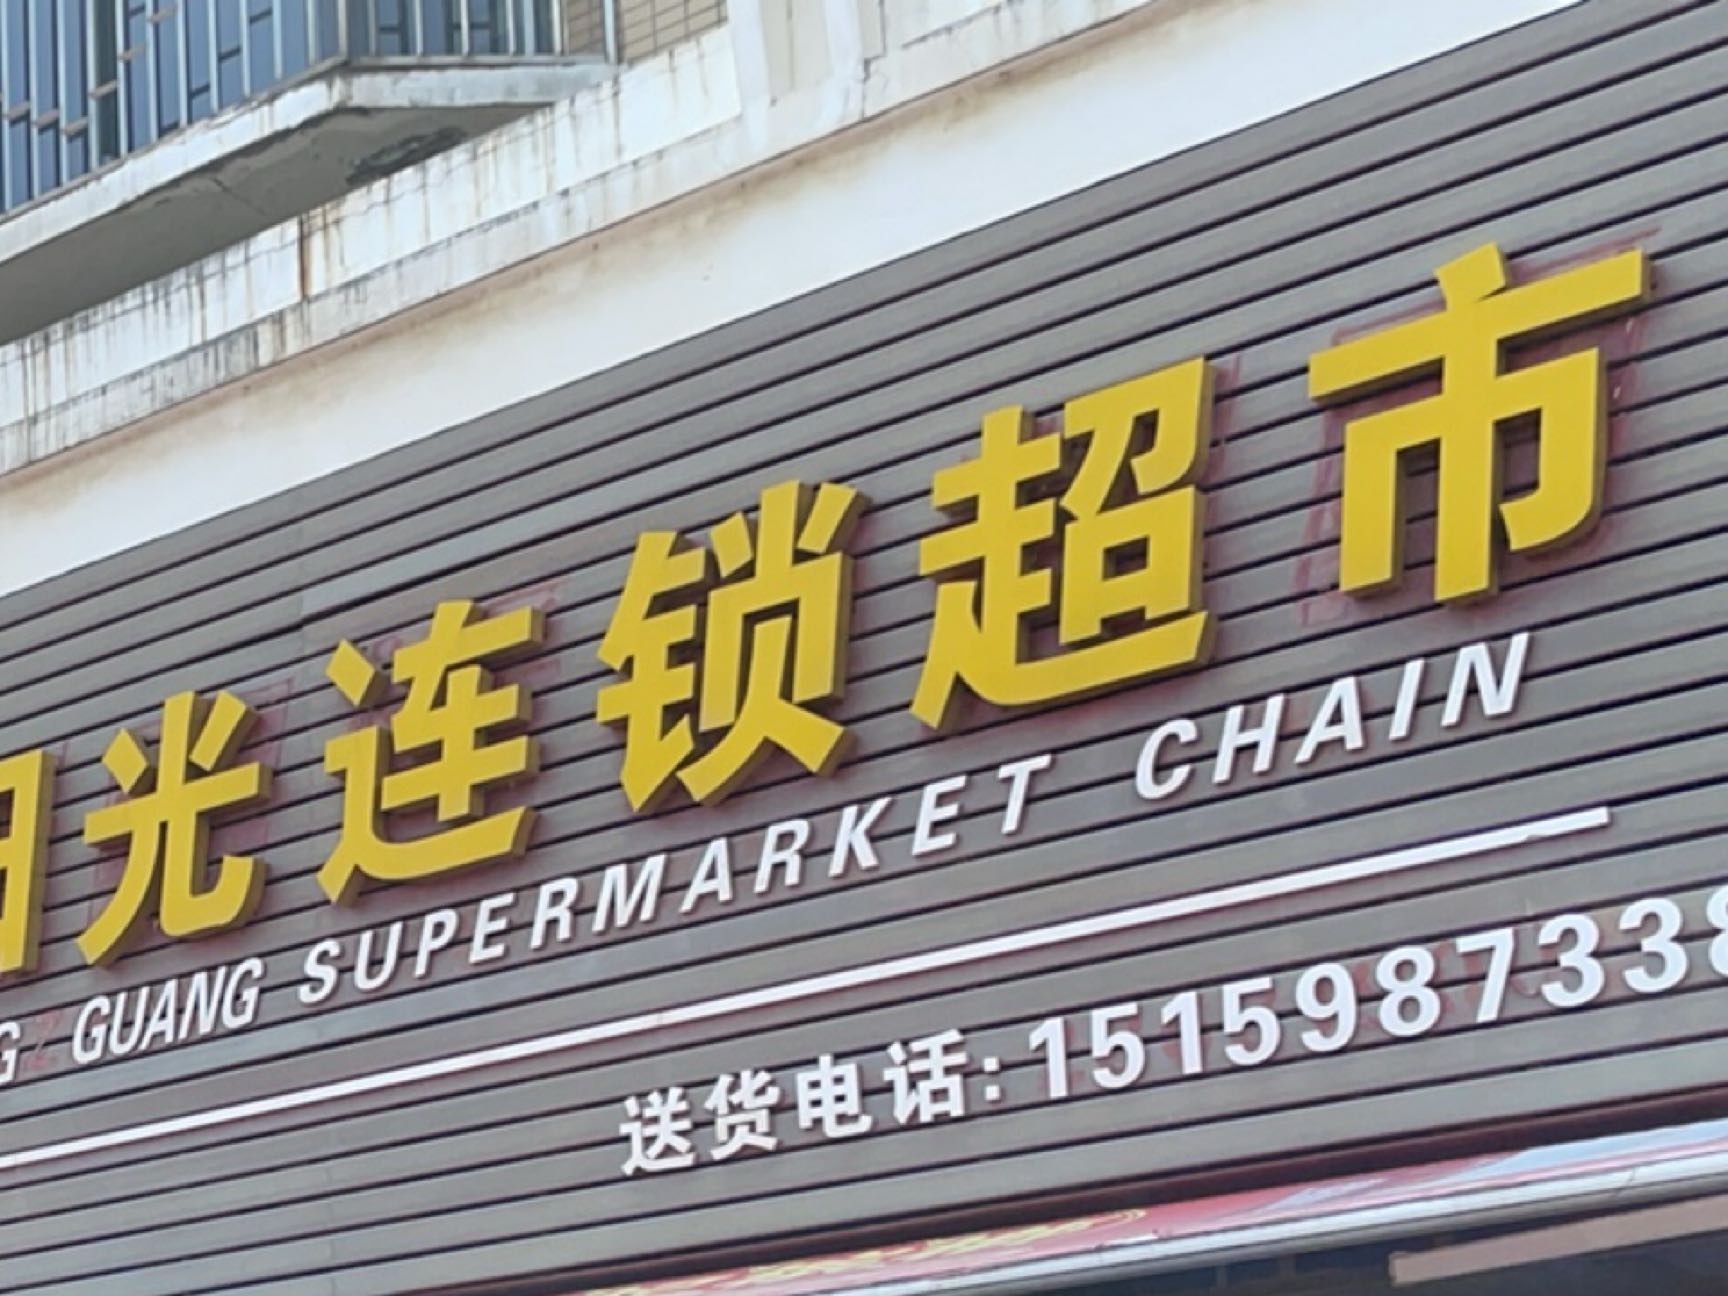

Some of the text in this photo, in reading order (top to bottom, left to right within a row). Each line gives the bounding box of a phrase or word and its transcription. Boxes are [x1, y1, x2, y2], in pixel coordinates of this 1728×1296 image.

[72, 956, 268, 1067] GUANG
[297, 755, 1050, 1002] SUPERMARKET
[1134, 632, 1531, 803] CHAIN
